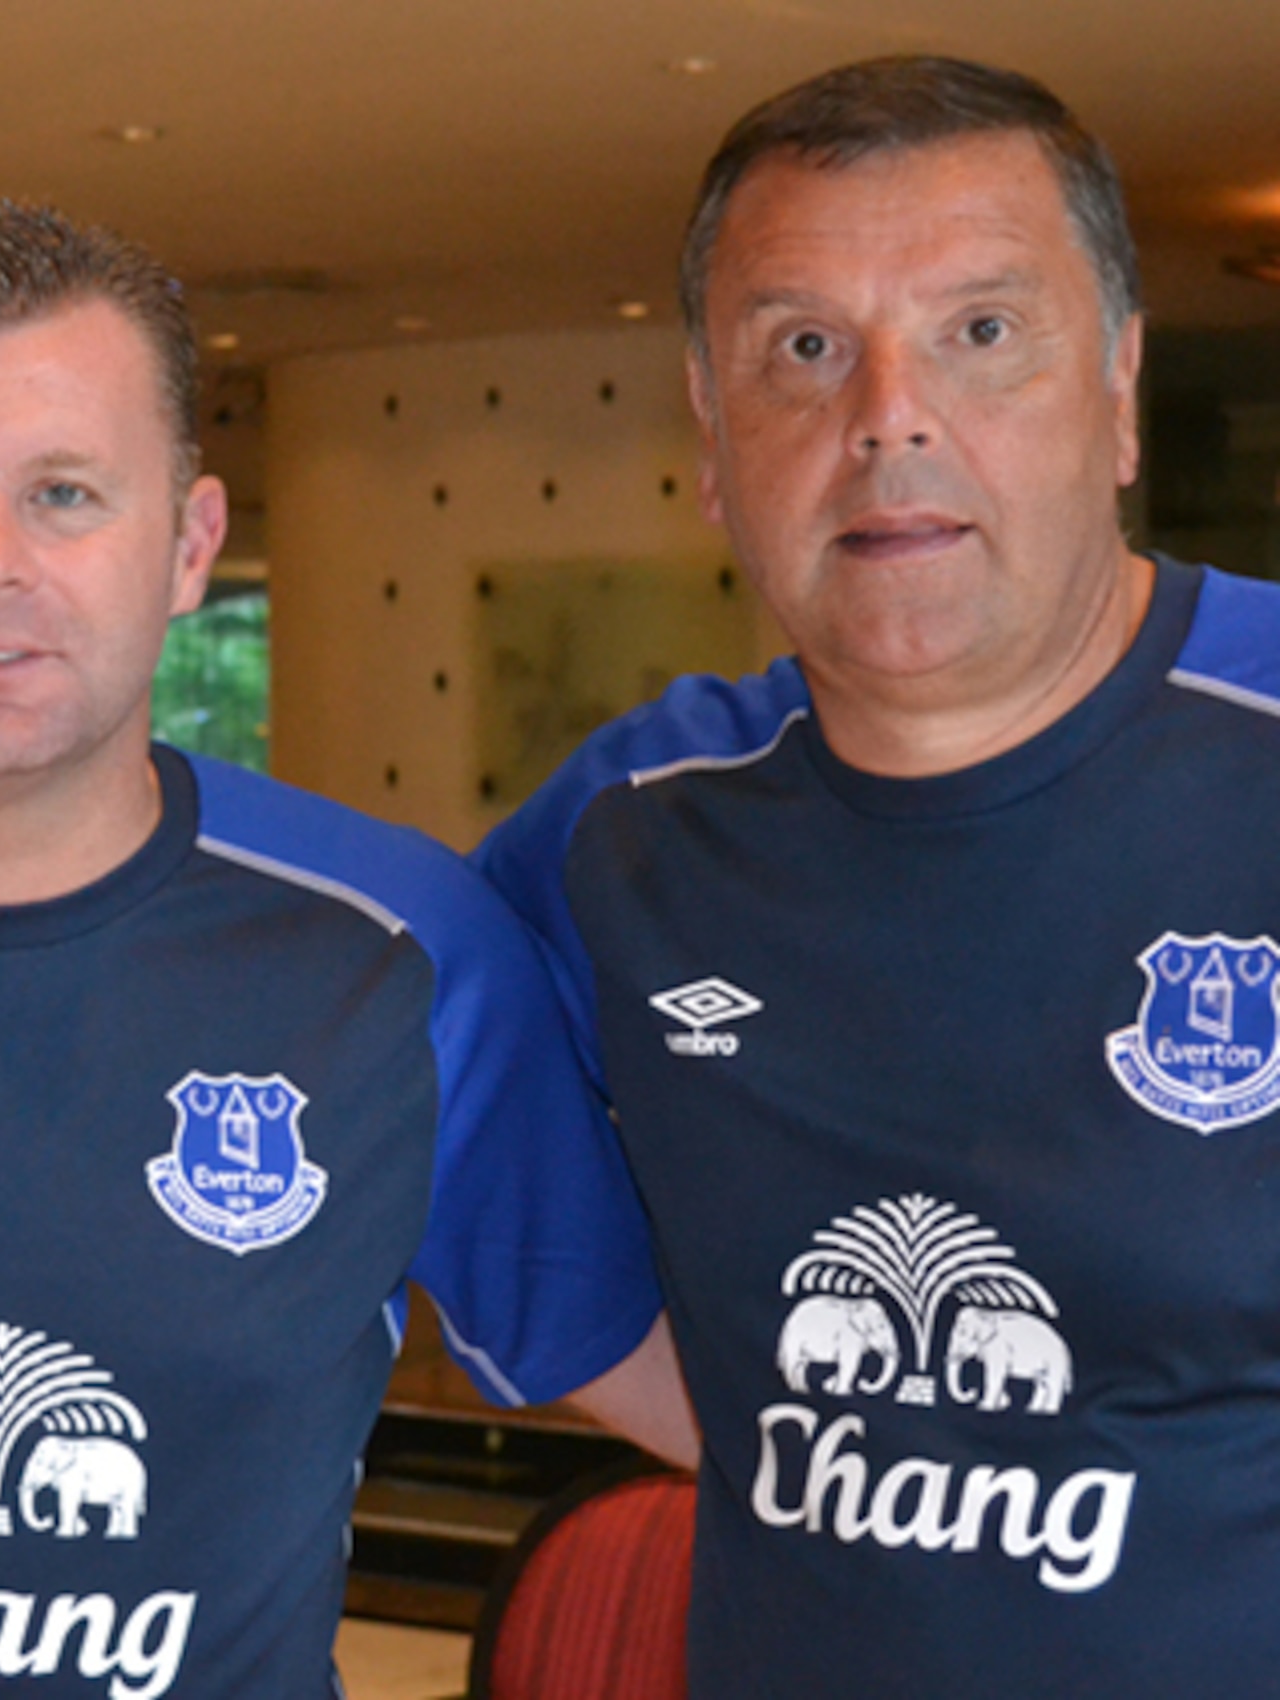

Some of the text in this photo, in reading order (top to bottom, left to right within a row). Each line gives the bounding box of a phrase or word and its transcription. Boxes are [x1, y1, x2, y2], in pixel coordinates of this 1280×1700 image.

[1155, 1036, 1263, 1067] Everton
[191, 1163, 285, 1194] Everton
[753, 1403, 1137, 1592] Chang
